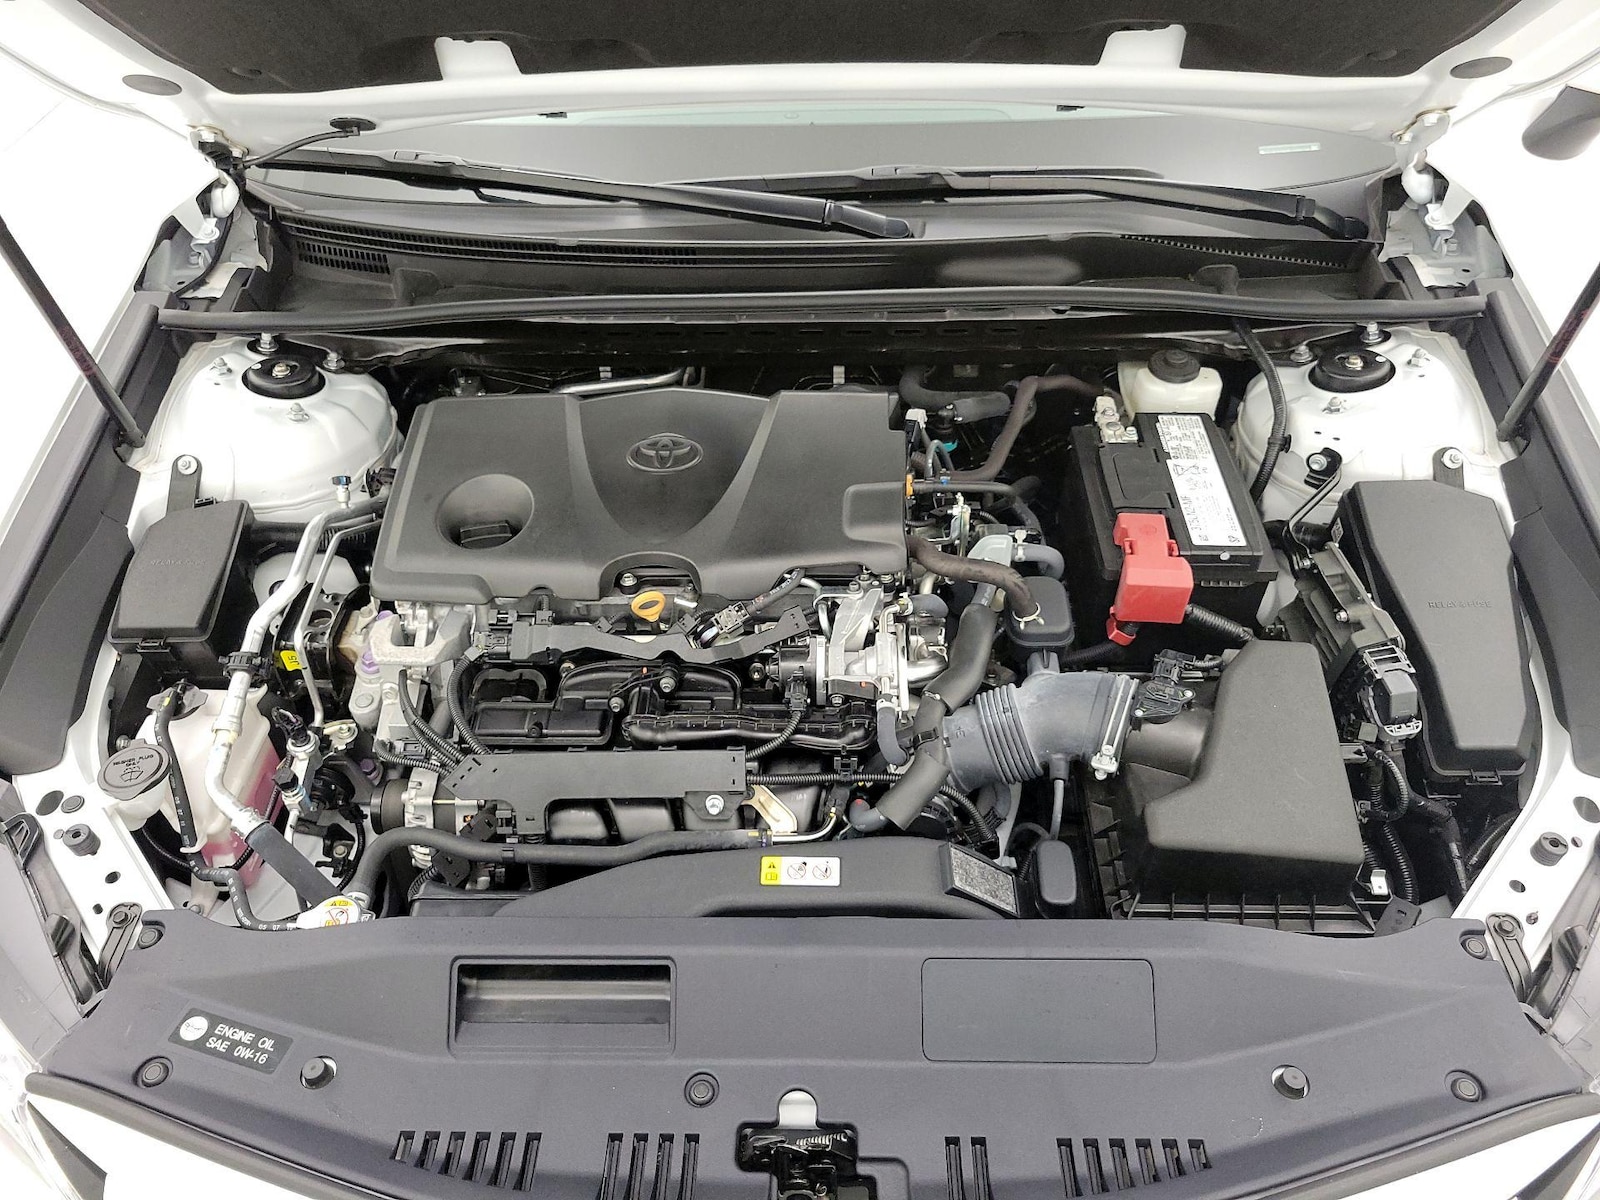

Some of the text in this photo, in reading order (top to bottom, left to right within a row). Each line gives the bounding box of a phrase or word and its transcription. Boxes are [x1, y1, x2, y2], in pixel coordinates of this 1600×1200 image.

[205, 1037, 268, 1064] SAE 0W-16
[215, 1024, 275, 1052] ENGINE OIL
